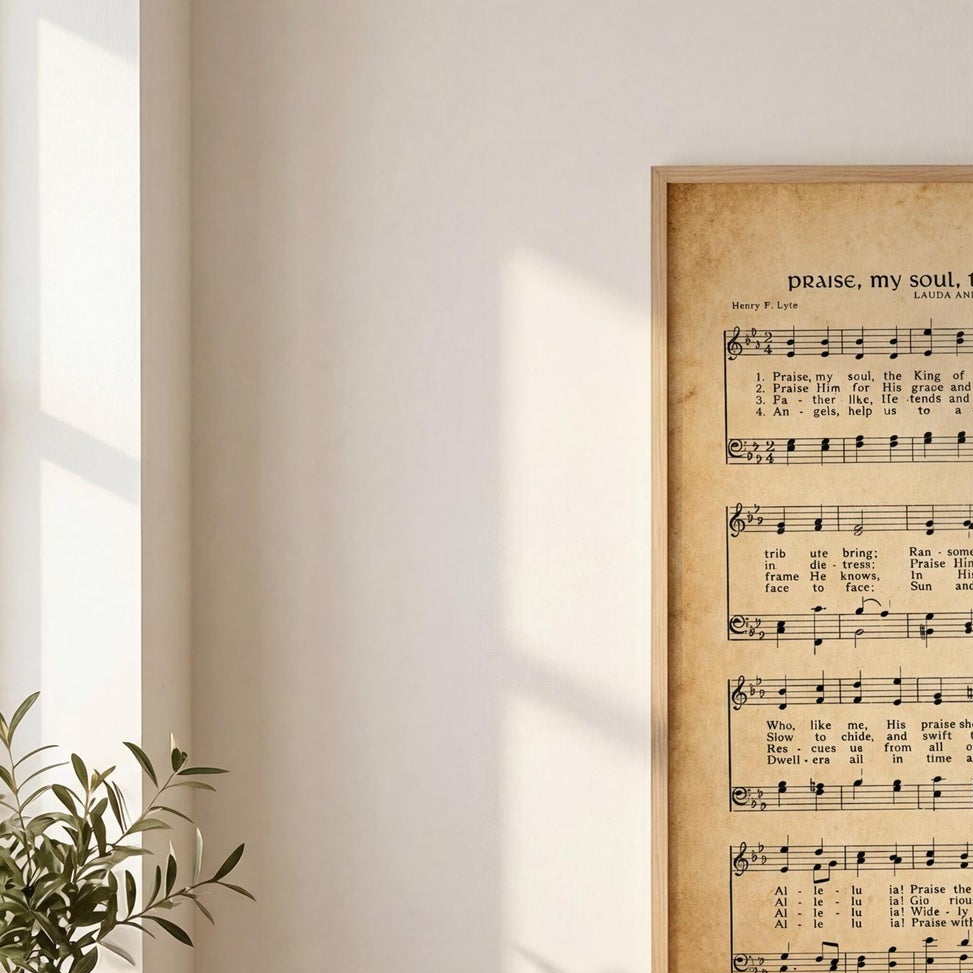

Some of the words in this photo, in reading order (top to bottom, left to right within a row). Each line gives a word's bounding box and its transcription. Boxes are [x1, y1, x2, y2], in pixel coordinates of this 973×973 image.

[870, 275, 901, 291] my
[910, 272, 960, 288] soul,
[914, 291, 951, 299] LAUDA
[732, 302, 760, 311] Henry
[777, 301, 798, 310] Lyte
[757, 373, 764, 381] 1.
[773, 372, 811, 383] Praise,
[816, 374, 832, 384] my
[884, 371, 902, 380] the
[914, 370, 941, 382] King
[953, 370, 965, 380] of
[756, 384, 765, 393] 2.
[773, 383, 808, 393] Praise
[817, 383, 840, 392] Him
[853, 383, 870, 392] for
[883, 382, 902, 392] His
[951, 382, 971, 391] and
[756, 396, 765, 405] 3.
[812, 395, 836, 404] ther
[949, 393, 969, 403] and
[756, 407, 765, 416] 4.
[773, 407, 789, 416] An
[814, 406, 839, 418] gels,
[849, 405, 872, 418] help
[918, 407, 930, 415] to
[765, 548, 786, 558] trib
[810, 550, 828, 558] ute
[909, 547, 931, 556] Ran
[765, 561, 775, 570] in
[911, 558, 945, 568] Praise
[765, 572, 799, 581] frame
[810, 571, 826, 581] He
[841, 571, 880, 581] knows,
[766, 583, 789, 592] face
[813, 584, 824, 592] to
[911, 581, 932, 591] Sun
[811, 720, 831, 730] like
[887, 720, 906, 729] His
[921, 719, 956, 731] praise
[767, 732, 793, 742] Slow
[815, 733, 826, 741] to
[887, 731, 907, 741] and
[923, 730, 952, 740] swift
[767, 744, 788, 753] Res
[884, 742, 911, 752] from
[929, 742, 943, 751] all
[767, 755, 800, 764] Dwell
[927, 754, 952, 763] time
[910, 884, 945, 894] Praise
[953, 884, 971, 894] the
[911, 906, 939, 916] Wide
[958, 906, 968, 919] ly
[912, 918, 946, 927] Praise
